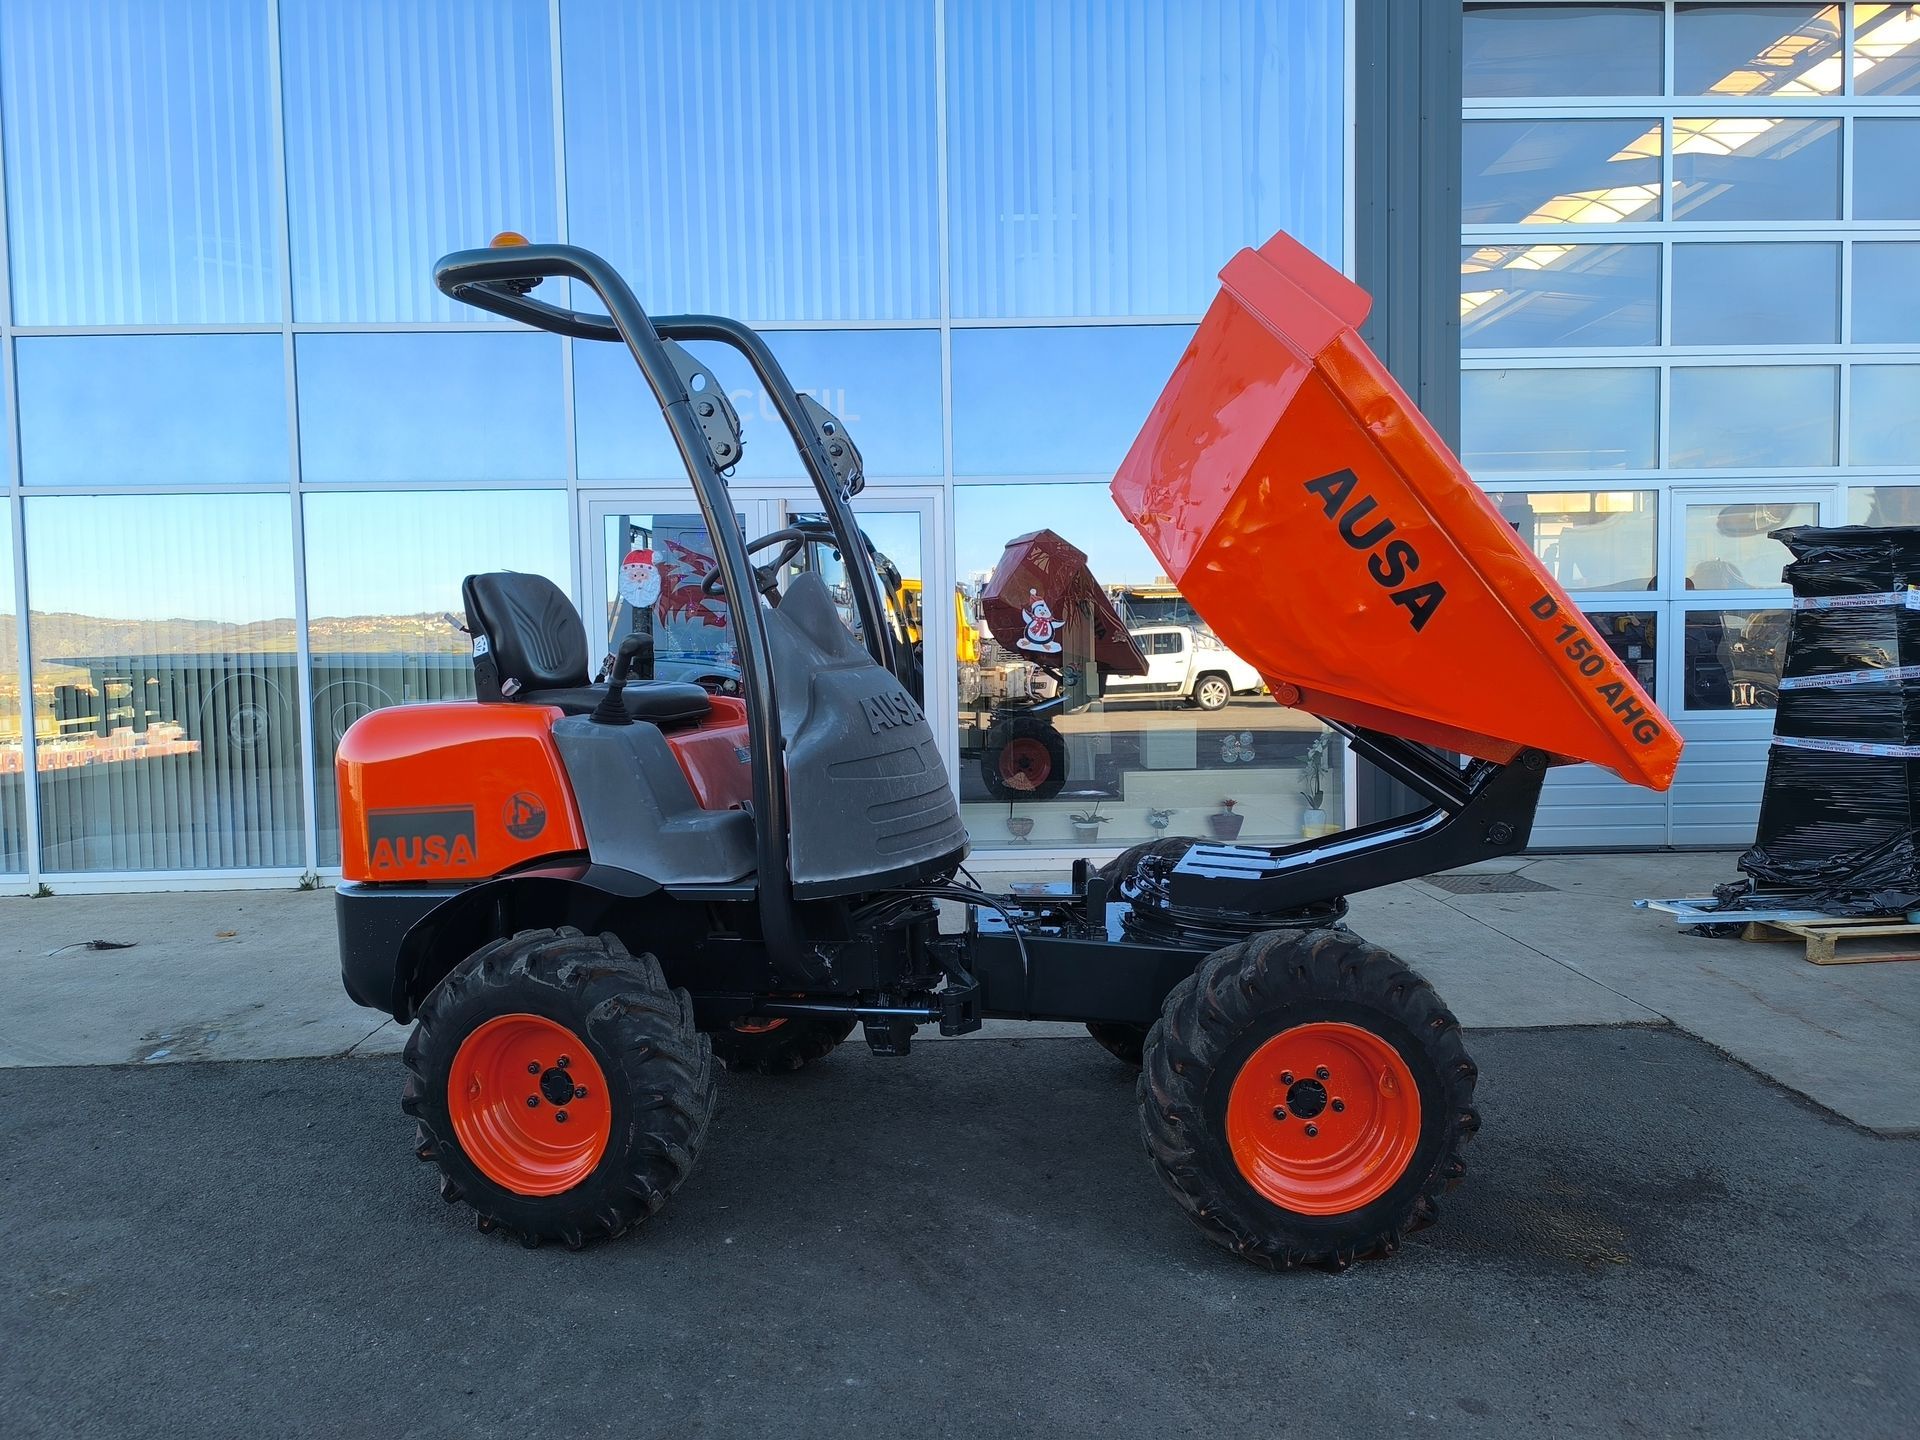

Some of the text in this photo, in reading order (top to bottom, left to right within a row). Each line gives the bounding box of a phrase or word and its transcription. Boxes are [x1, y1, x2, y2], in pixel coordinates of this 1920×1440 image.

[1302, 467, 1447, 634] AUSA
[859, 690, 926, 735] AUSA
[1529, 593, 1661, 745] D 150 AHG
[371, 834, 476, 870] AUSA
